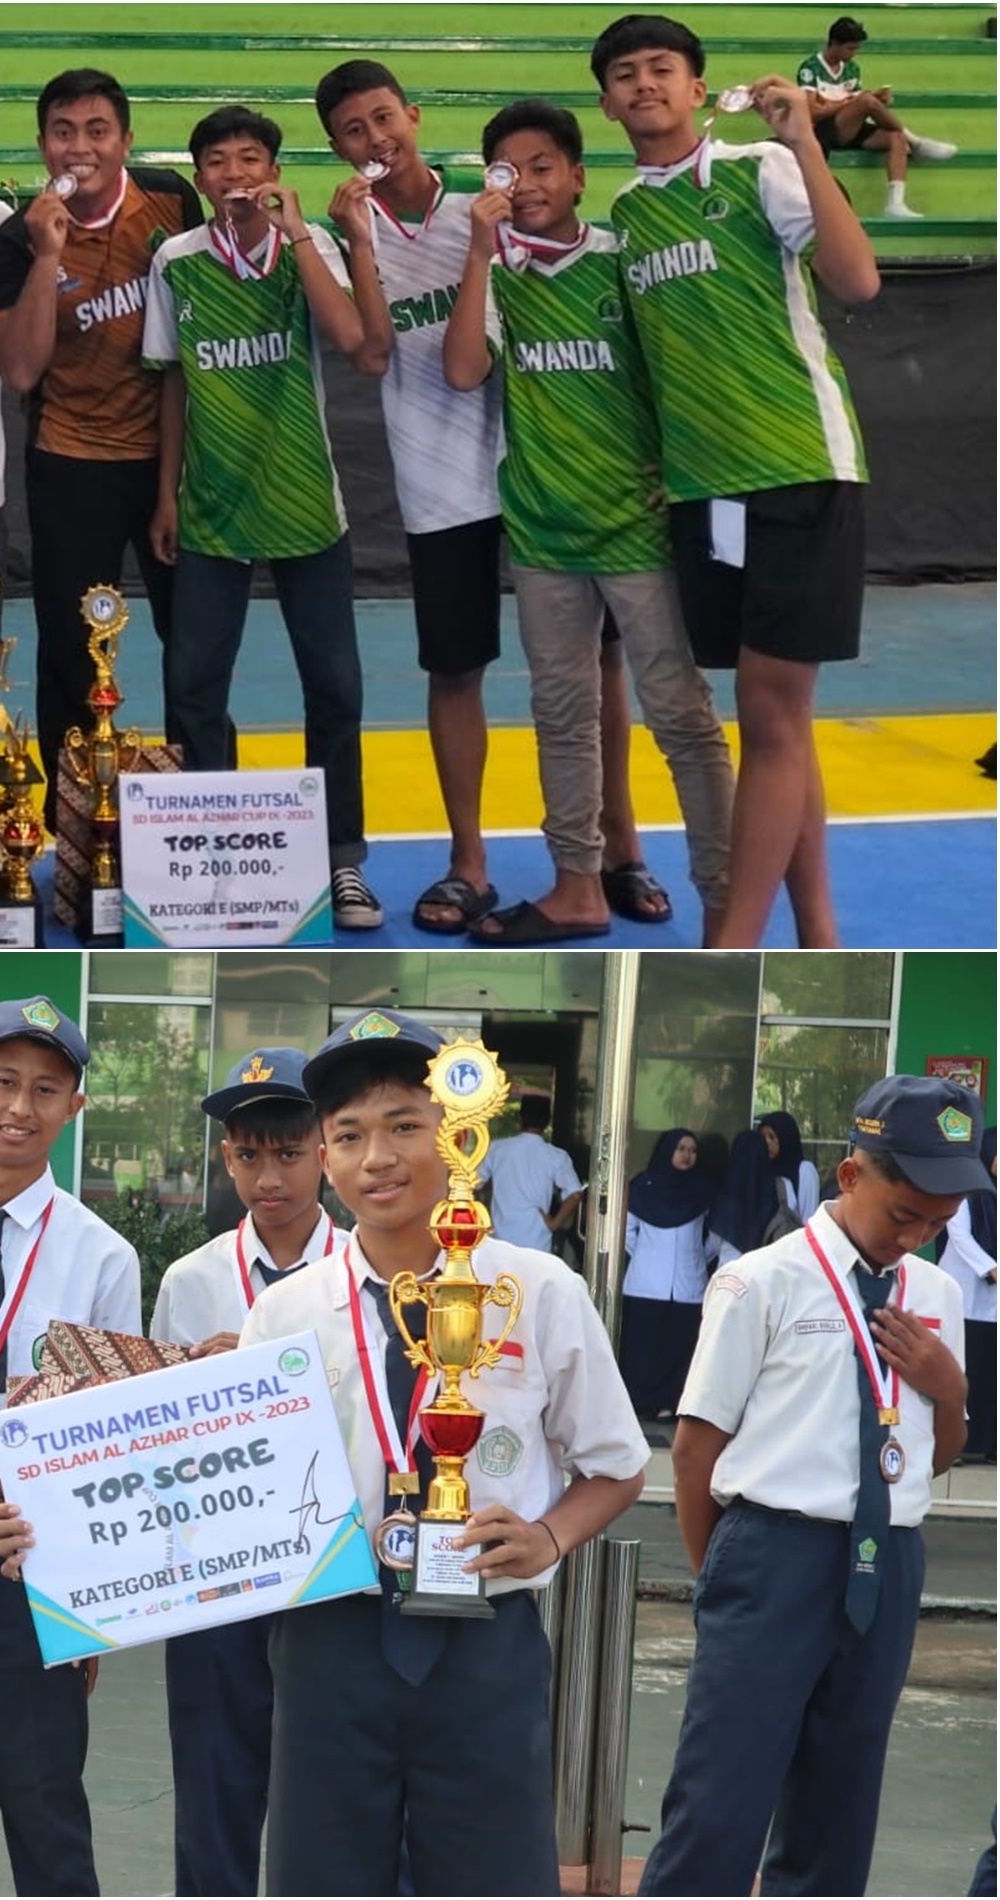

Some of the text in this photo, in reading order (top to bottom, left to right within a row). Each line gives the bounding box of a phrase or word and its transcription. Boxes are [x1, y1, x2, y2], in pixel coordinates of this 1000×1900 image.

[627, 239, 719, 295] SWANDA
[75, 276, 149, 332] SWAN
[389, 284, 461, 333] SWAN
[146, 793, 303, 810] TURNAMEN FUTSAL
[150, 814, 183, 823] ISLAM
[242, 812, 266, 821] CUP
[164, 832, 288, 852] TOP SCORE
[169, 859, 285, 880] Rp 200.000,-
[150, 903, 216, 916] KATEGORI
[229, 900, 299, 916] (SMP/MTs)
[32, 1376, 290, 1455] TURNAMEN FUTSAL
[17, 1464, 41, 1481] SD
[45, 1449, 99, 1475] ISLAM
[104, 1441, 124, 1458] AL
[129, 1427, 189, 1453] AZHAR
[193, 1415, 232, 1438] CUP
[236, 1409, 256, 1425] IX
[72, 1438, 275, 1508] TOP SCORE
[89, 1485, 275, 1546] Rp 200.000,-
[439, 1536, 454, 1546] TO
[69, 1568, 178, 1609] KATEGORI
[182, 1563, 194, 1583] E
[199, 1534, 310, 1580] (SMP/MTs)
